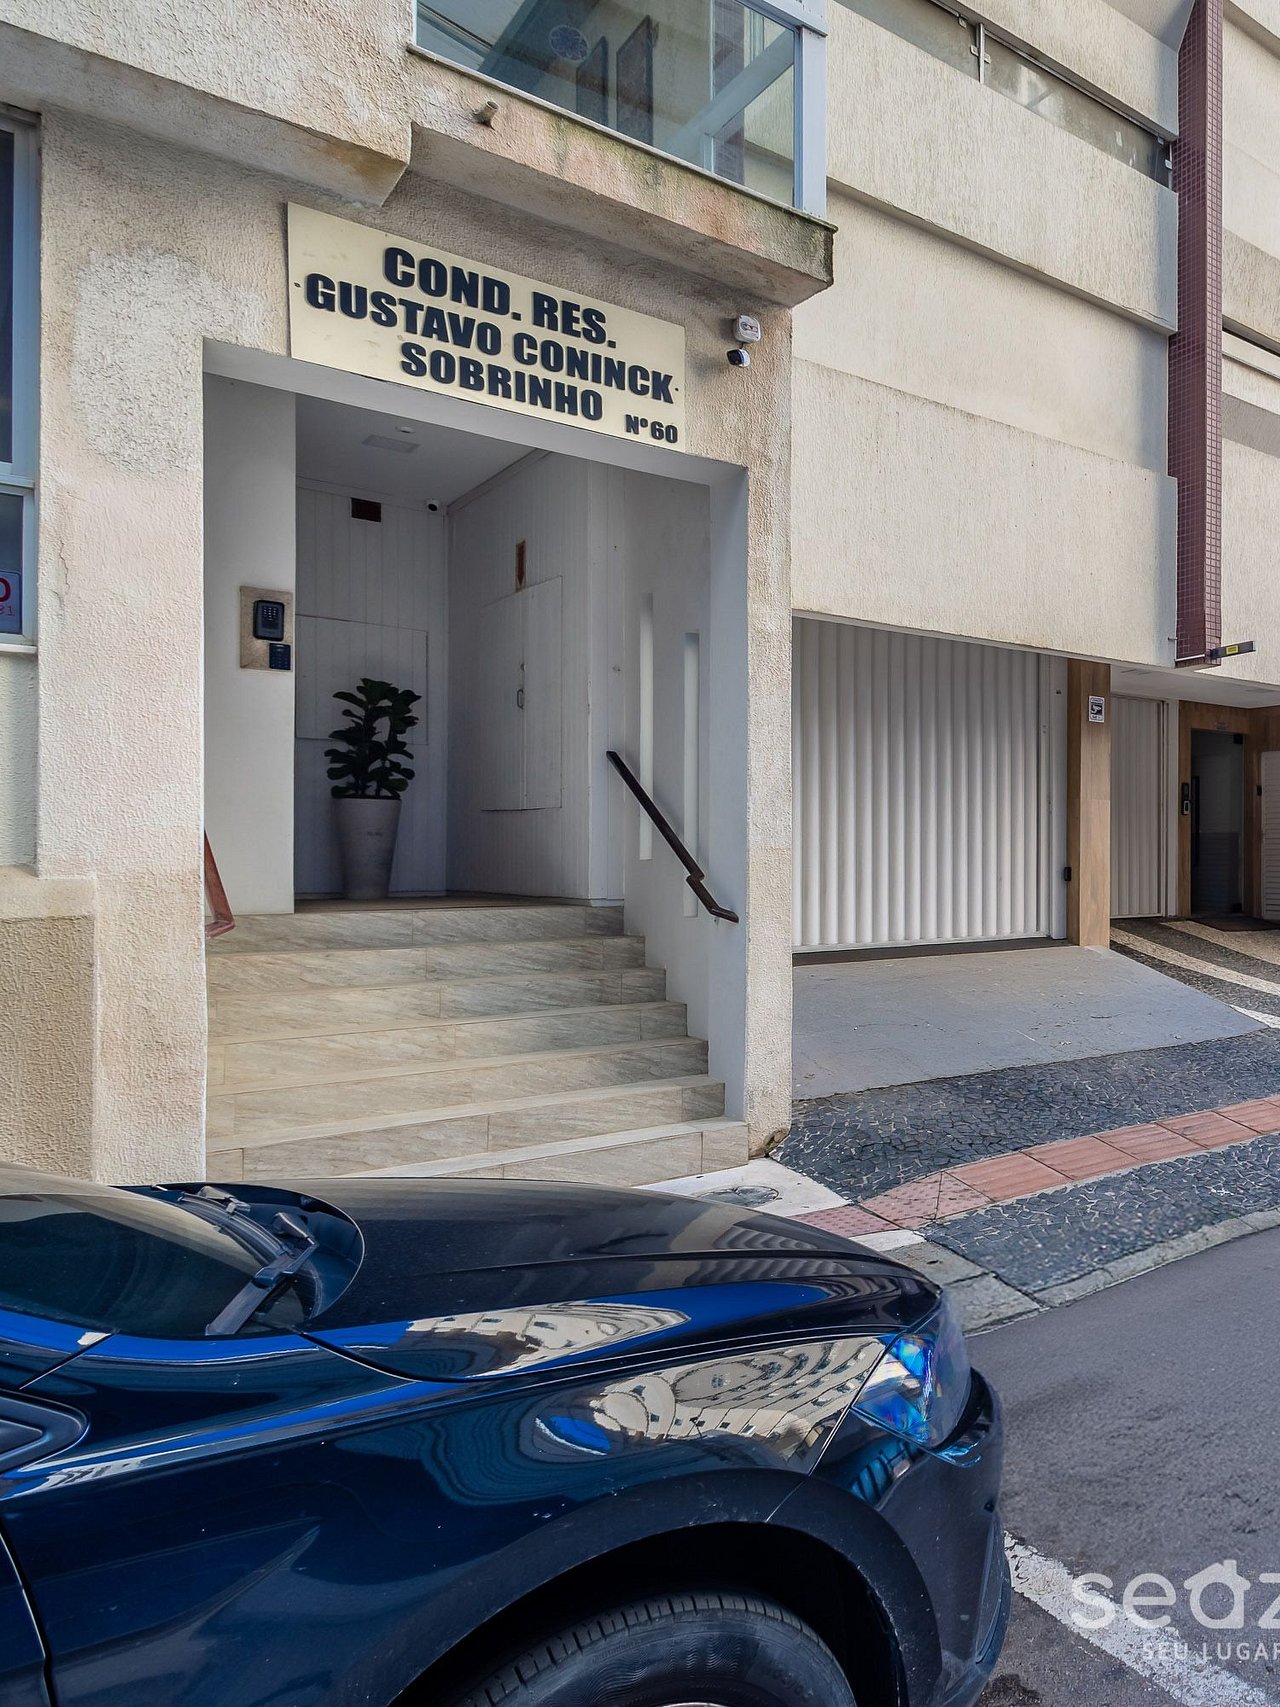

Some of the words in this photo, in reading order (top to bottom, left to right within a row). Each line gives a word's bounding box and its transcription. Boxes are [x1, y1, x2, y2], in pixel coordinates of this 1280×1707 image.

[305, 272, 503, 357] GUSTAVO
[512, 331, 674, 406] CONINCK
[383, 246, 522, 322] COND.
[531, 291, 617, 349] RES.
[400, 341, 603, 421] SOBRINHO
